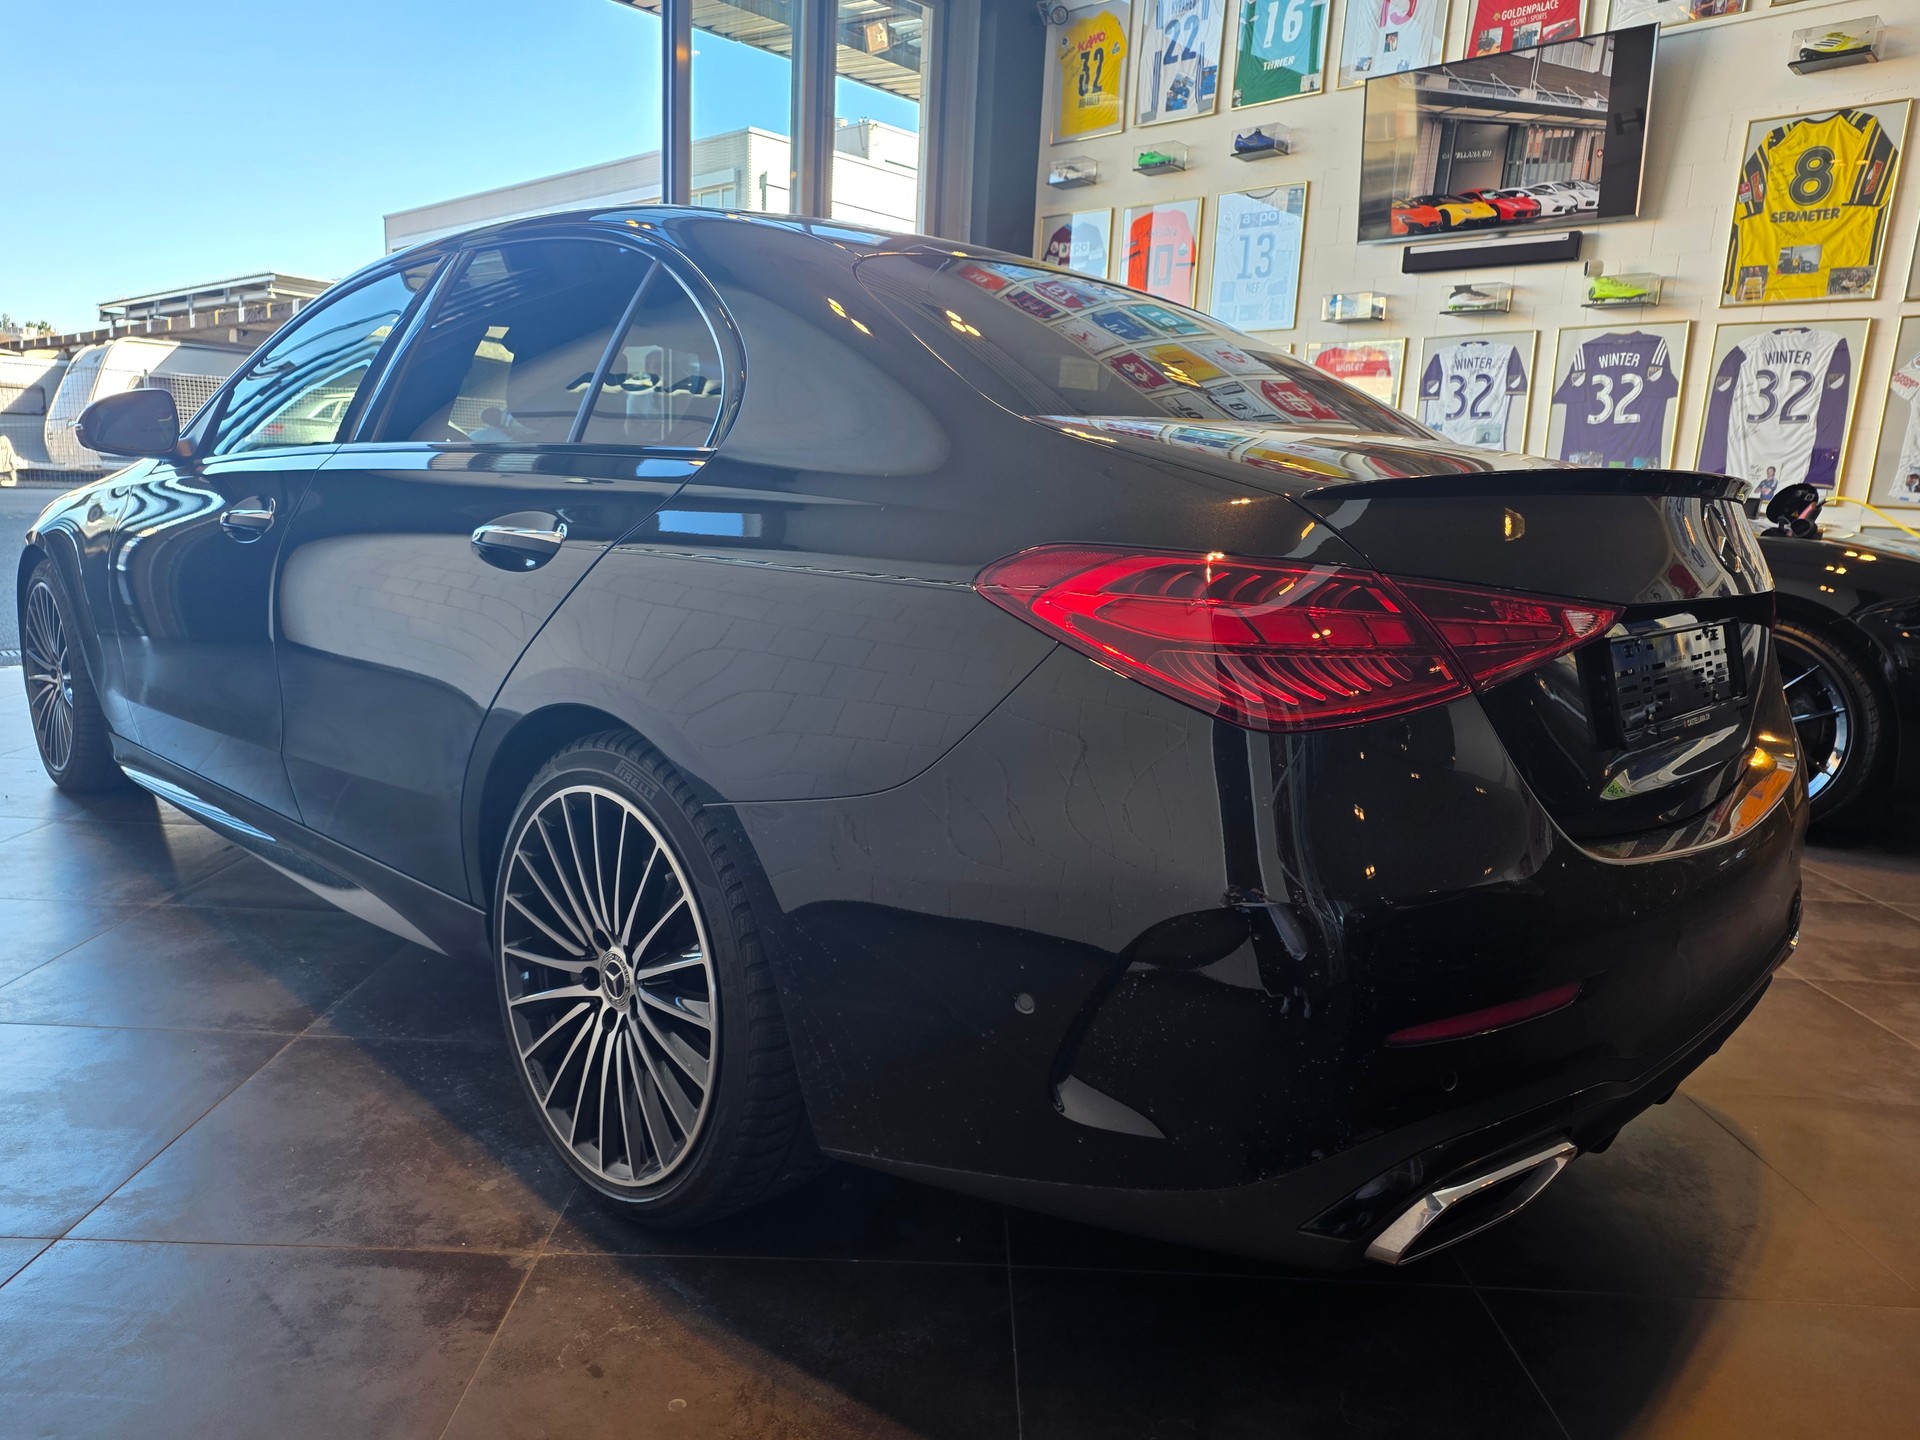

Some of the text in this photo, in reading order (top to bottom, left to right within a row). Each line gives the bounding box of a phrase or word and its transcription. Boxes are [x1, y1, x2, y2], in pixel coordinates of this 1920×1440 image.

[1263, 0, 1305, 49] 16
[1501, 0, 1559, 20] GOLDENPALACE
[1163, 15, 1199, 65] 22
[1078, 47, 1104, 97] 32
[1789, 145, 1836, 206] 8
[1770, 207, 1840, 224] SERMETER
[1237, 231, 1277, 279] 13
[1336, 361, 1365, 372] winter
[1454, 357, 1493, 370] WINTER
[1598, 352, 1640, 369] WINTER
[1765, 350, 1812, 366] WINTER
[1445, 373, 1495, 420] 32
[1587, 373, 1643, 425] 32
[1746, 369, 1815, 424] 32
